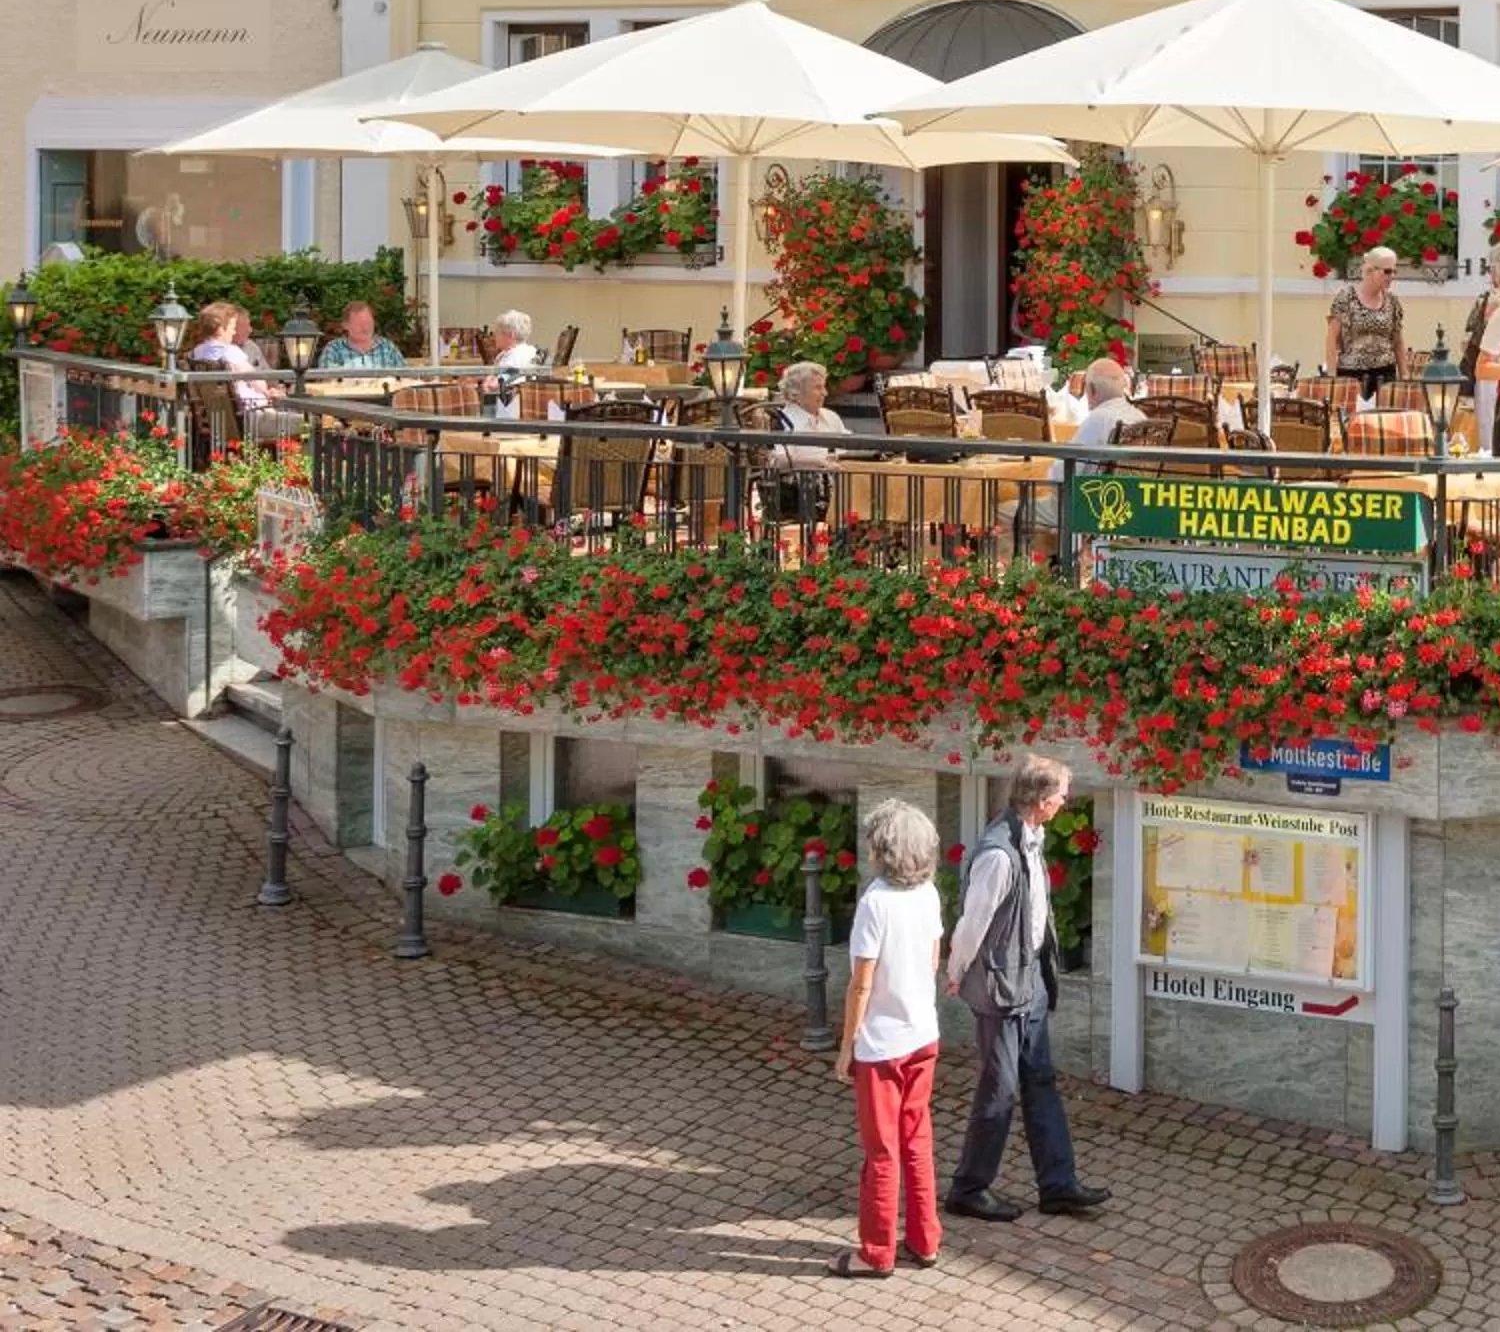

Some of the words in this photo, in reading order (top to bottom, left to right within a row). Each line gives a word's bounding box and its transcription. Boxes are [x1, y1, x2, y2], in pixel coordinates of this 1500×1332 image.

[1138, 481, 1404, 519] THERMALWASSER
[1178, 510, 1352, 545] HALLENBAD
[1328, 819, 1359, 837] Post
[1152, 970, 1206, 998] Hotel
[1212, 977, 1296, 1013] Eingang
